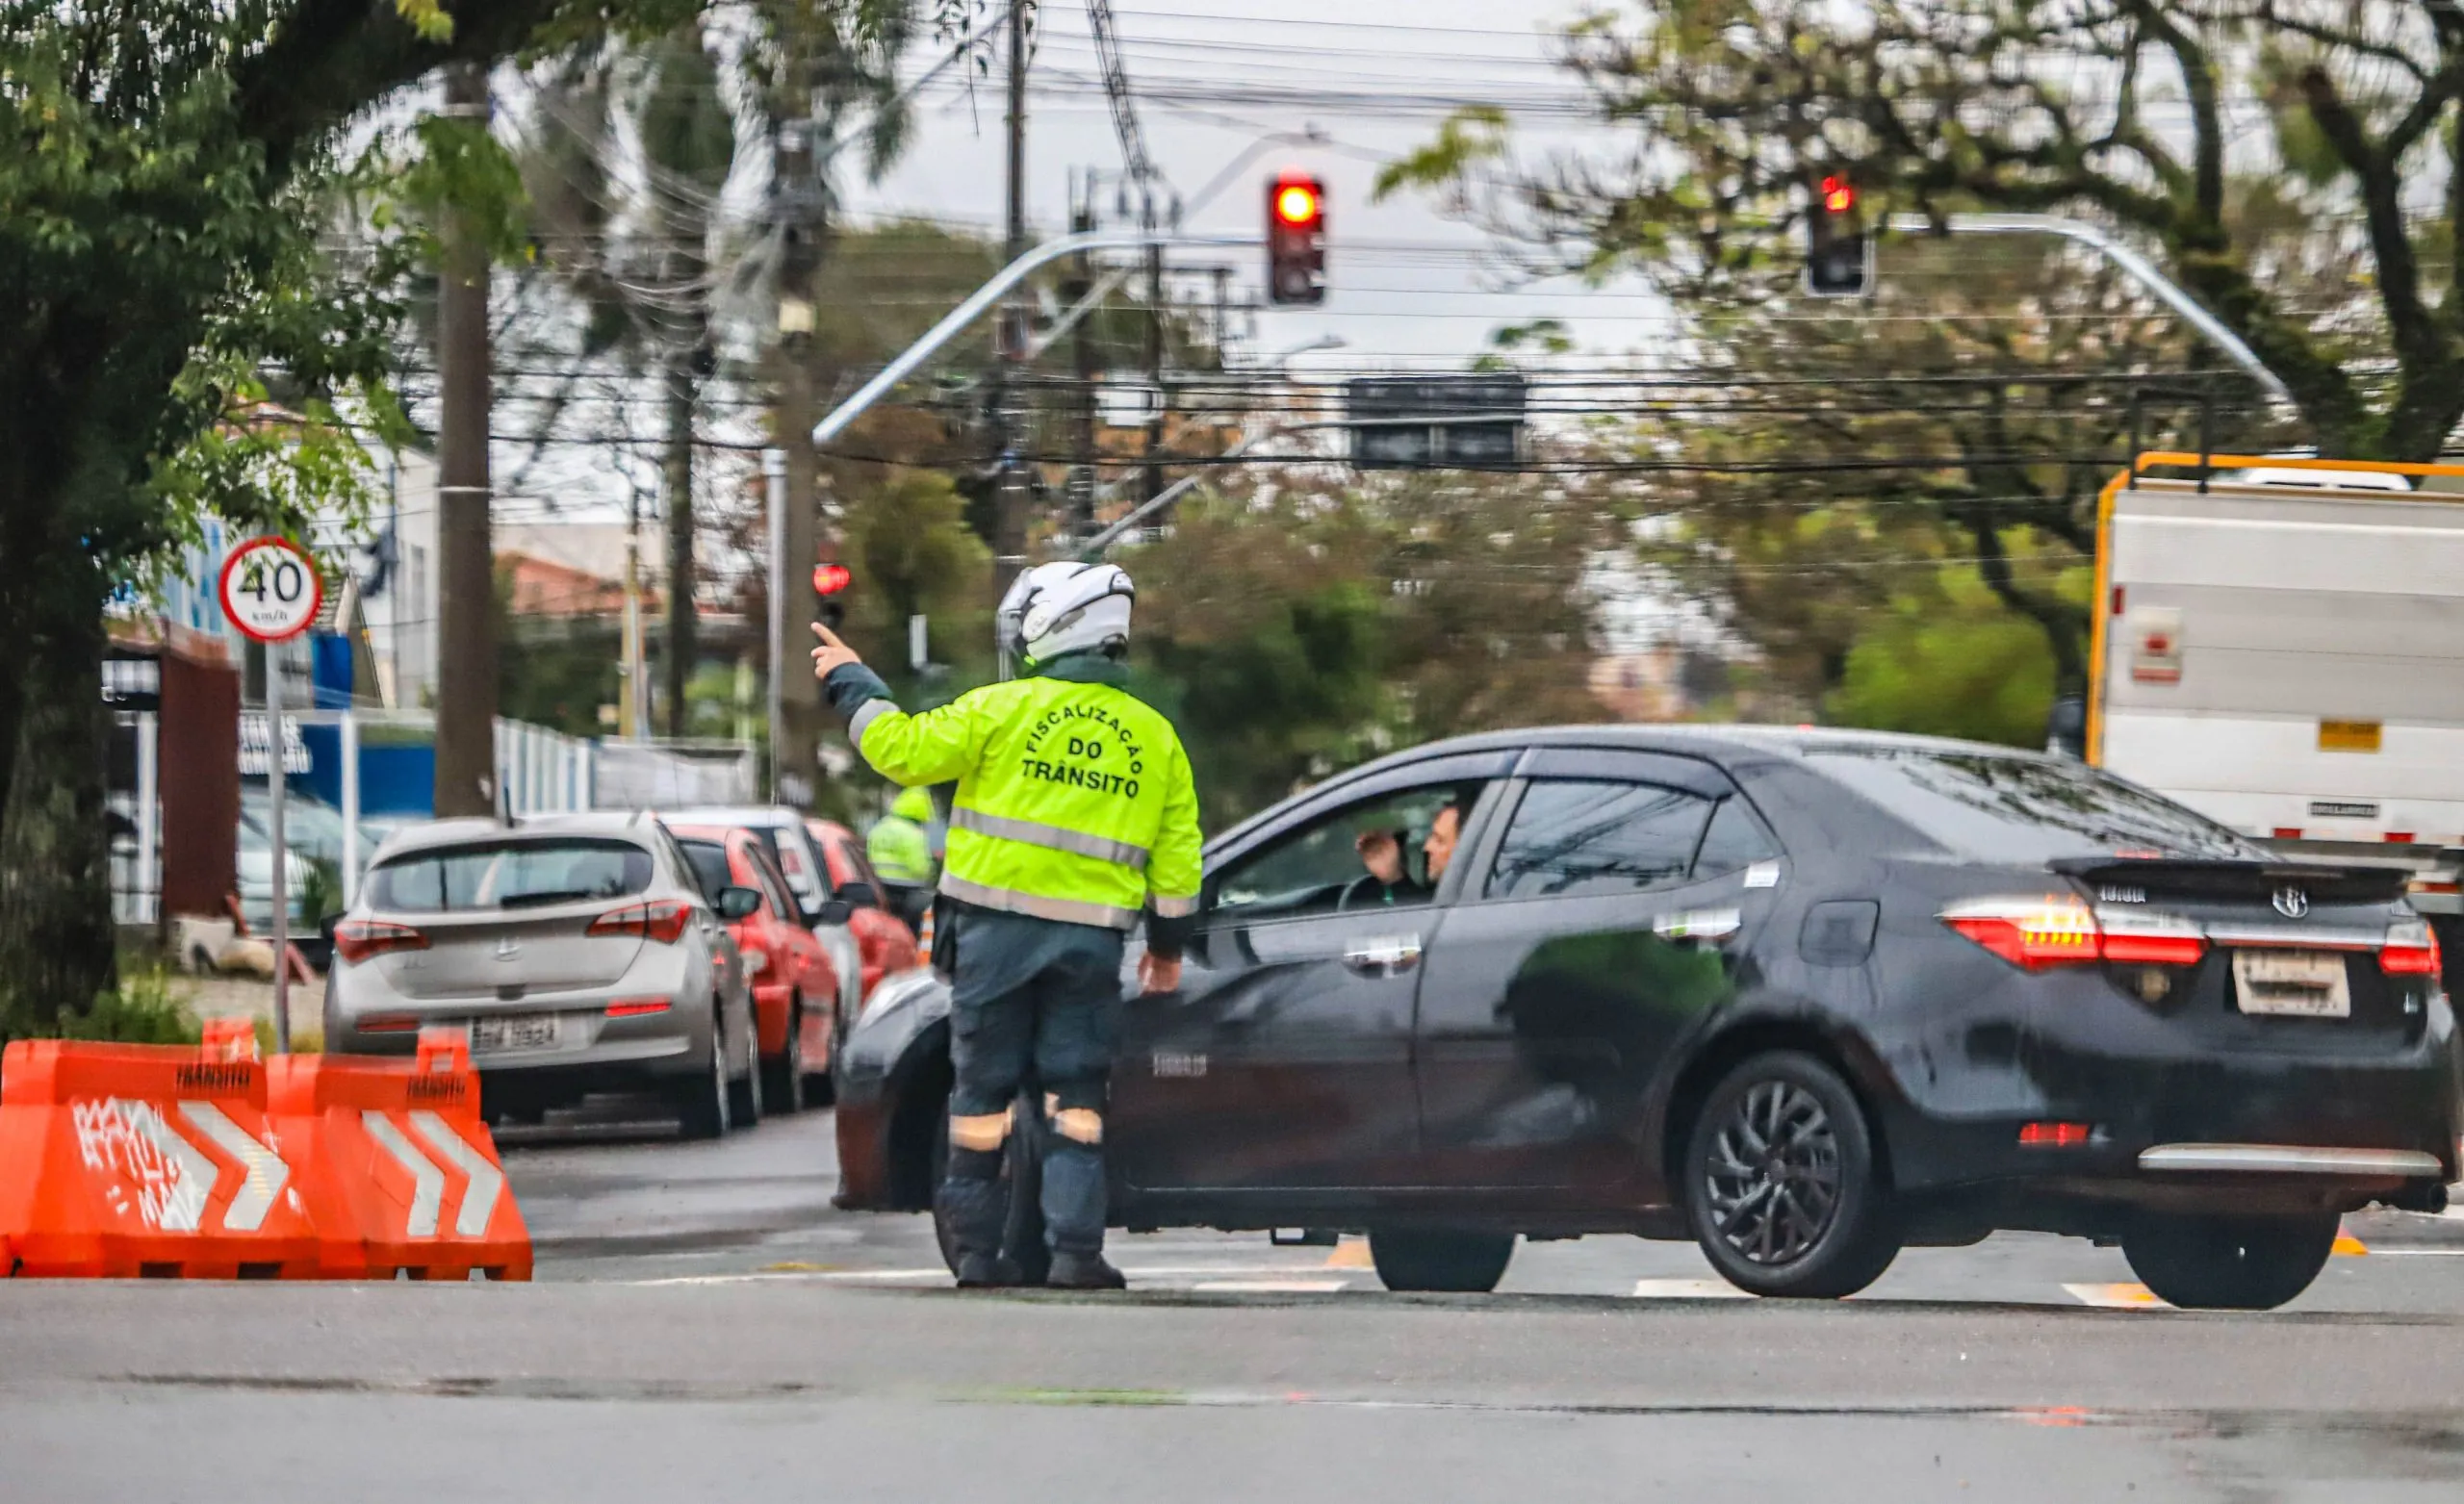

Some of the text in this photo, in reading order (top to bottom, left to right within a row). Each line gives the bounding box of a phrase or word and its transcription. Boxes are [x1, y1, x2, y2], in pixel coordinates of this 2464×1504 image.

[238, 561, 302, 602] 40
[1026, 703, 1143, 775] FISCALIZAÇÃO
[1068, 736, 1102, 759] DO
[1022, 758, 1139, 799] TRÂNSITO
